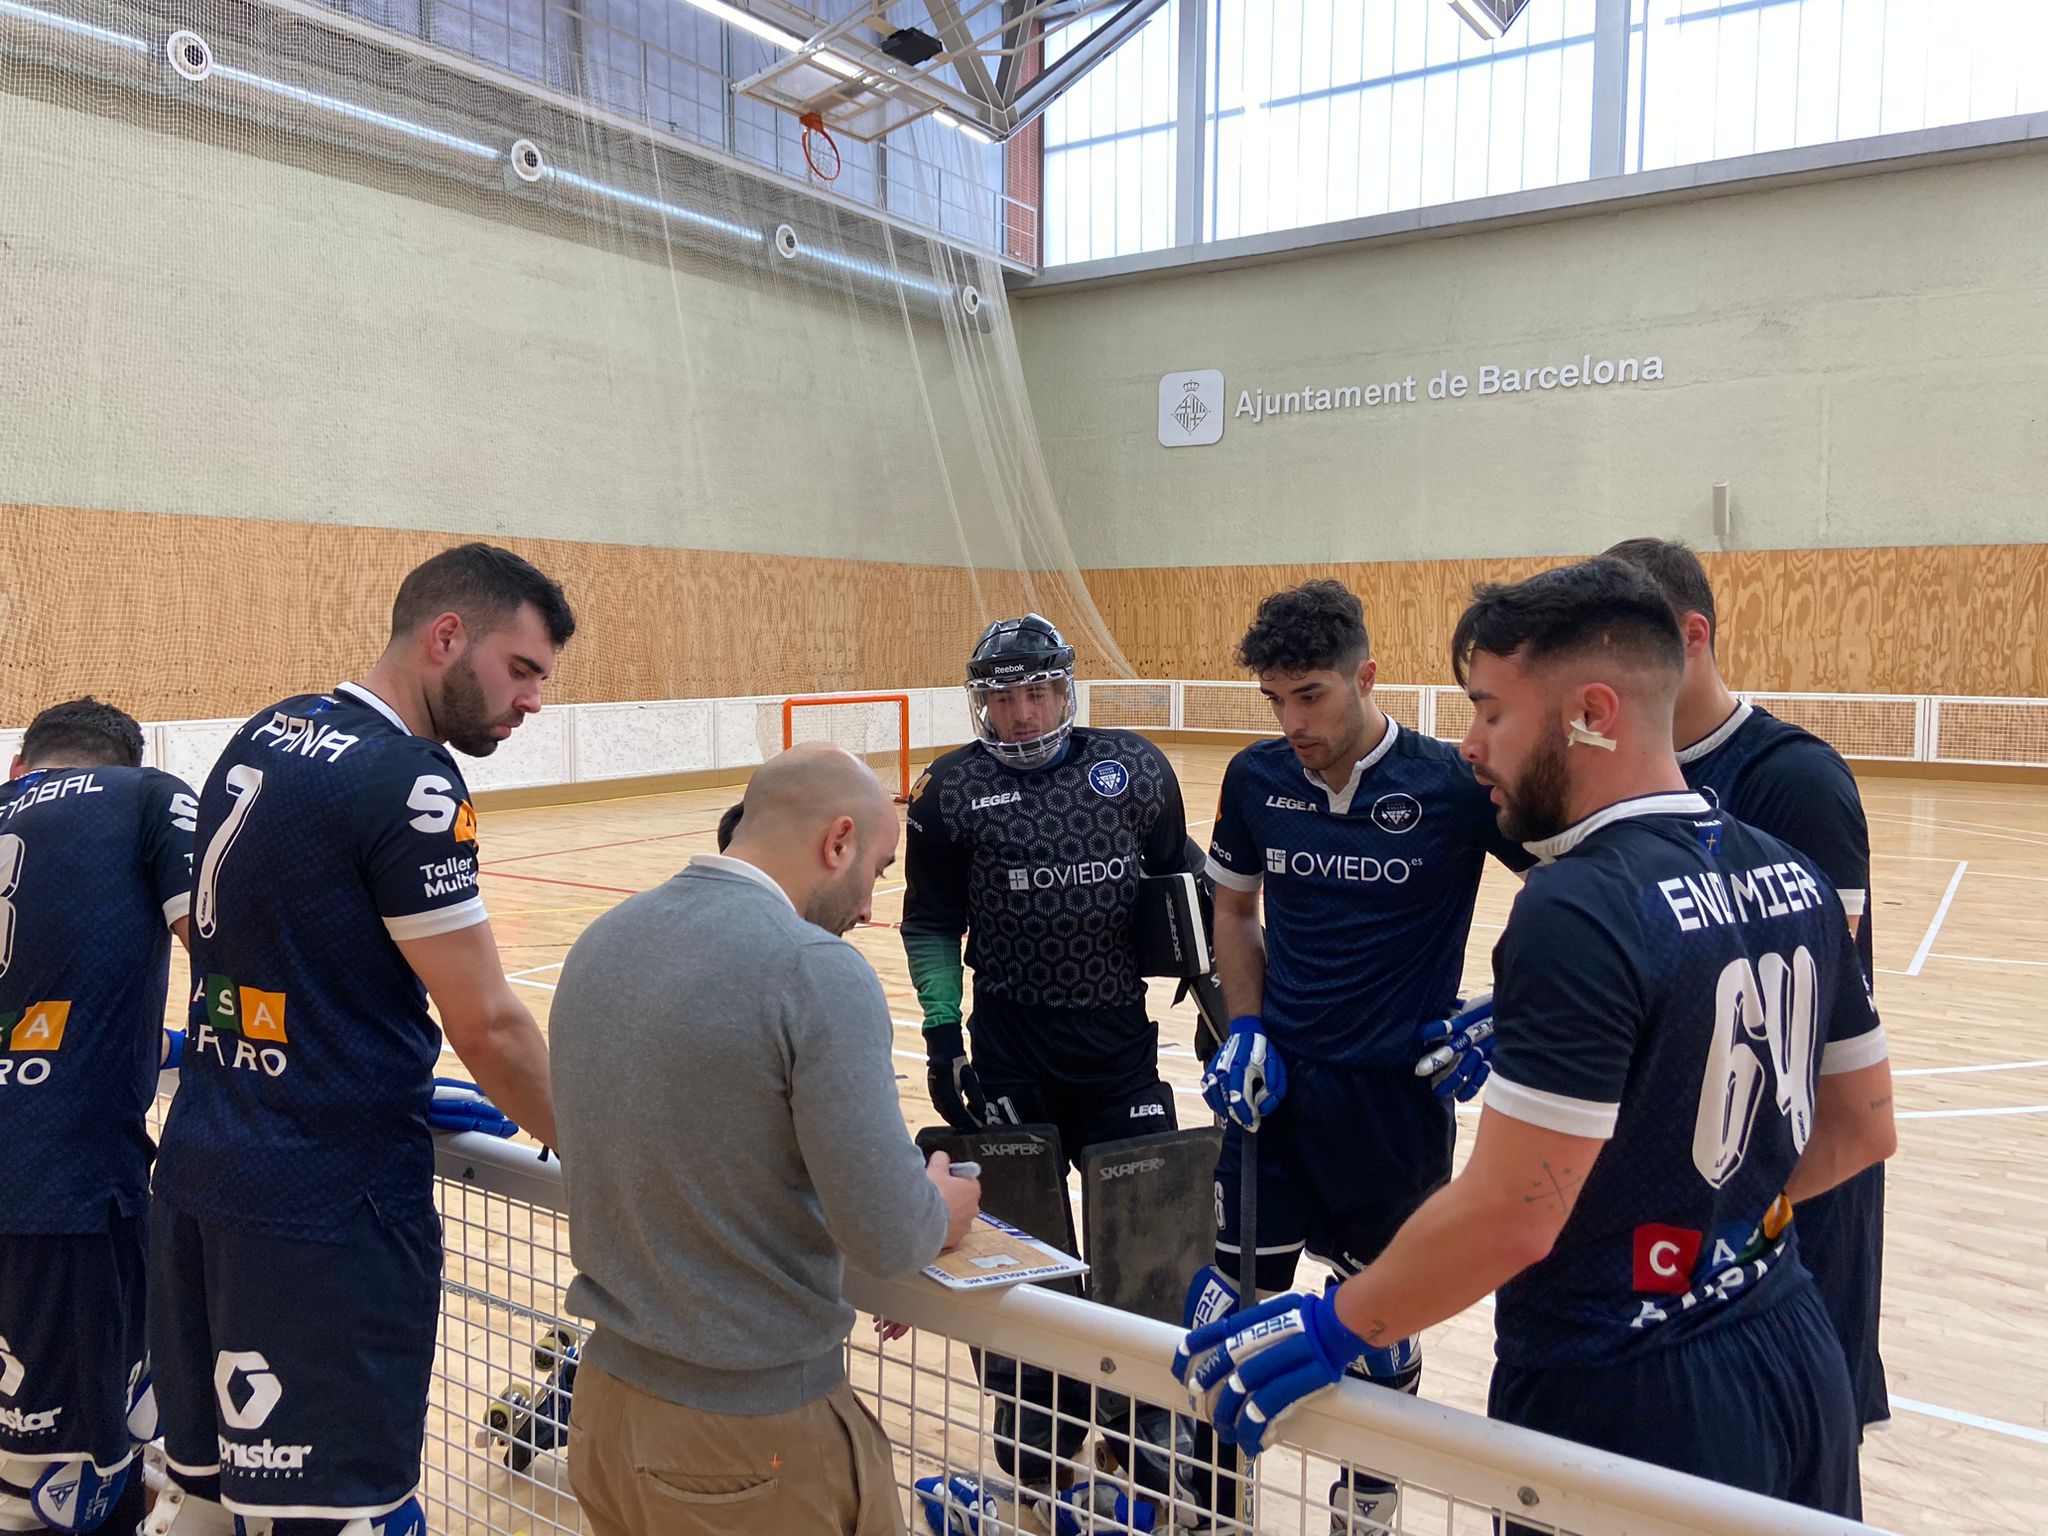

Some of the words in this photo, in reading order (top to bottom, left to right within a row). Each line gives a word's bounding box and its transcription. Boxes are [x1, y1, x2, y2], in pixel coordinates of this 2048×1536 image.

[1235, 374, 1417, 423] Ajuntament
[1427, 369, 1468, 399] de
[1478, 354, 1665, 396] Barcelona
[994, 663, 1025, 675] Reebok
[971, 791, 1023, 811] LEGEA
[1265, 795, 1319, 813] LEGEA
[195, 763, 264, 939] 7
[420, 857, 473, 880] Taller
[1692, 944, 1818, 1190] 64
